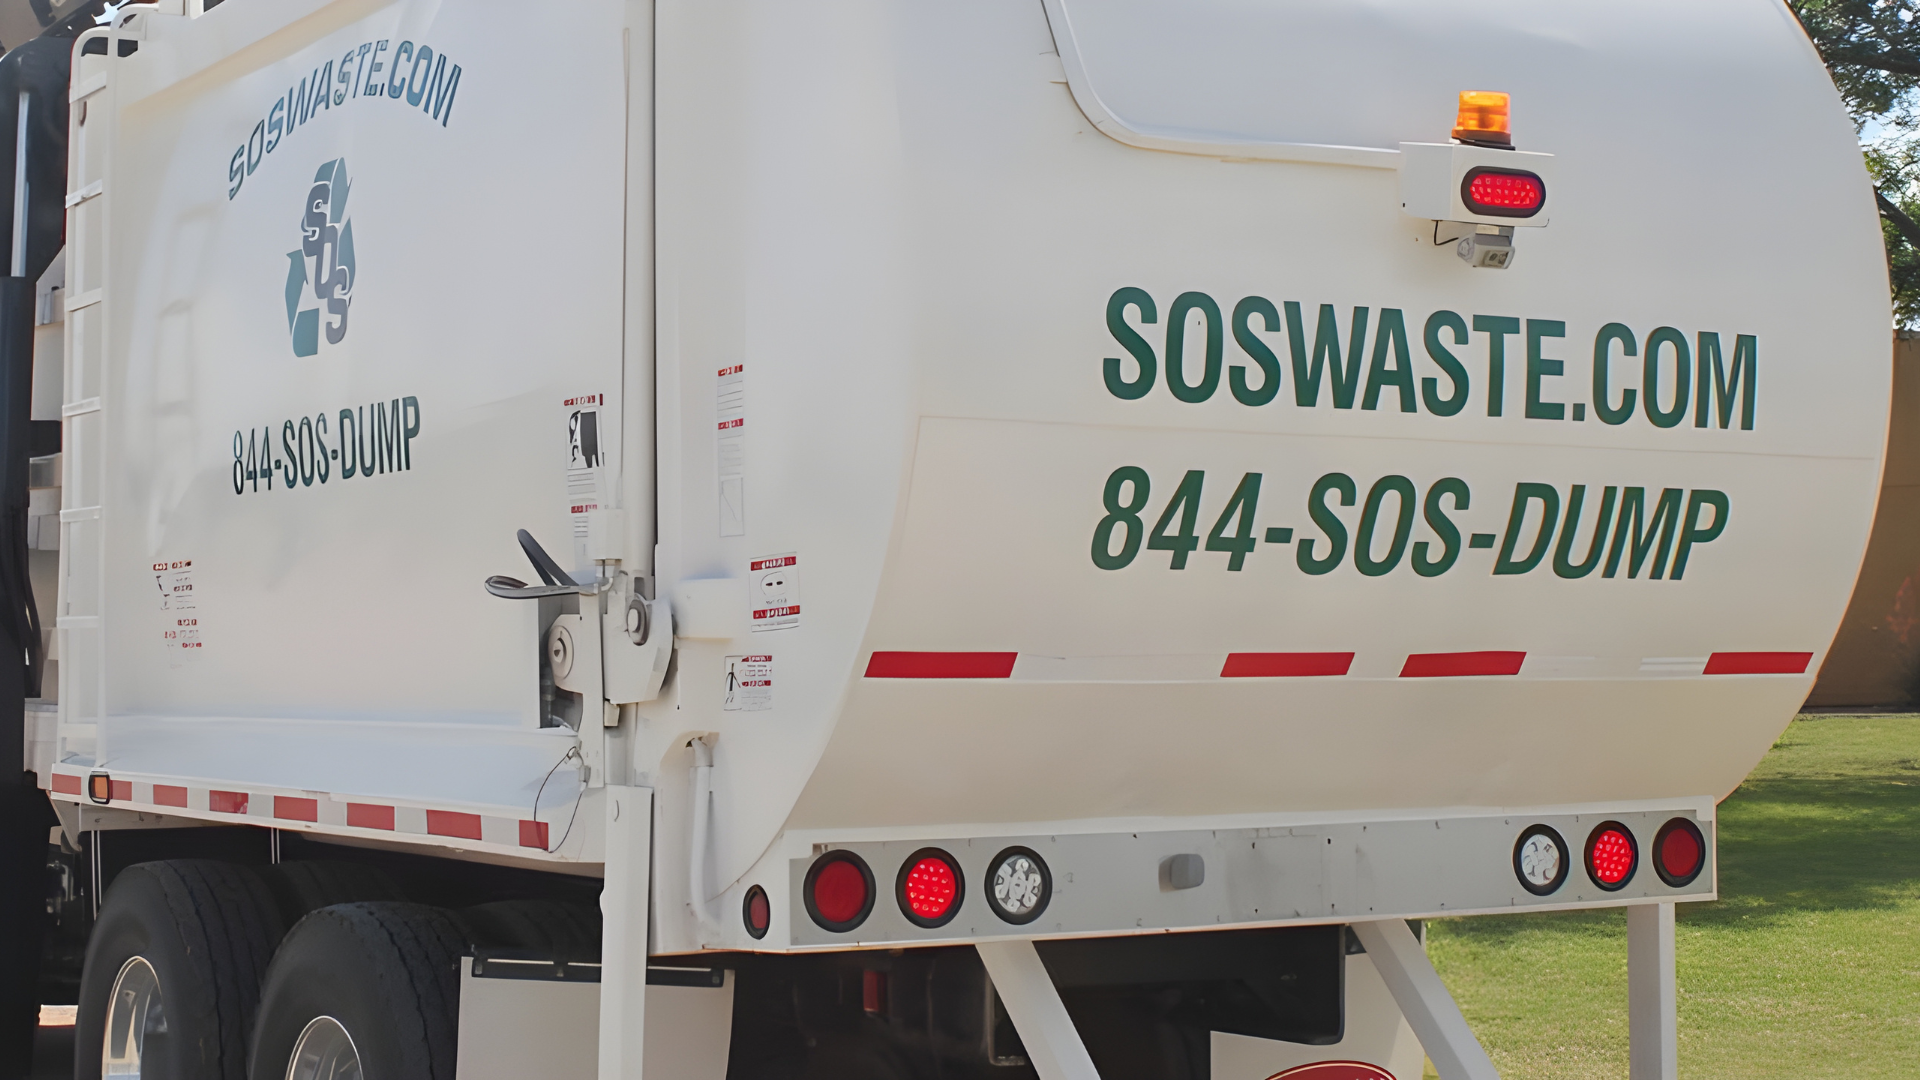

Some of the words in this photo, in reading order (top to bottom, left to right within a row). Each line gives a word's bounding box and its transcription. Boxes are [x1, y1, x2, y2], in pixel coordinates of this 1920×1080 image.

[228, 39, 462, 201] SOSWASTE.COM
[301, 182, 350, 345] SOS
[1102, 286, 1758, 431] SOSWASTE.COM
[233, 395, 421, 496] 844-SOS-DUMP
[1090, 465, 1731, 581] 844-SOS-DUMP
